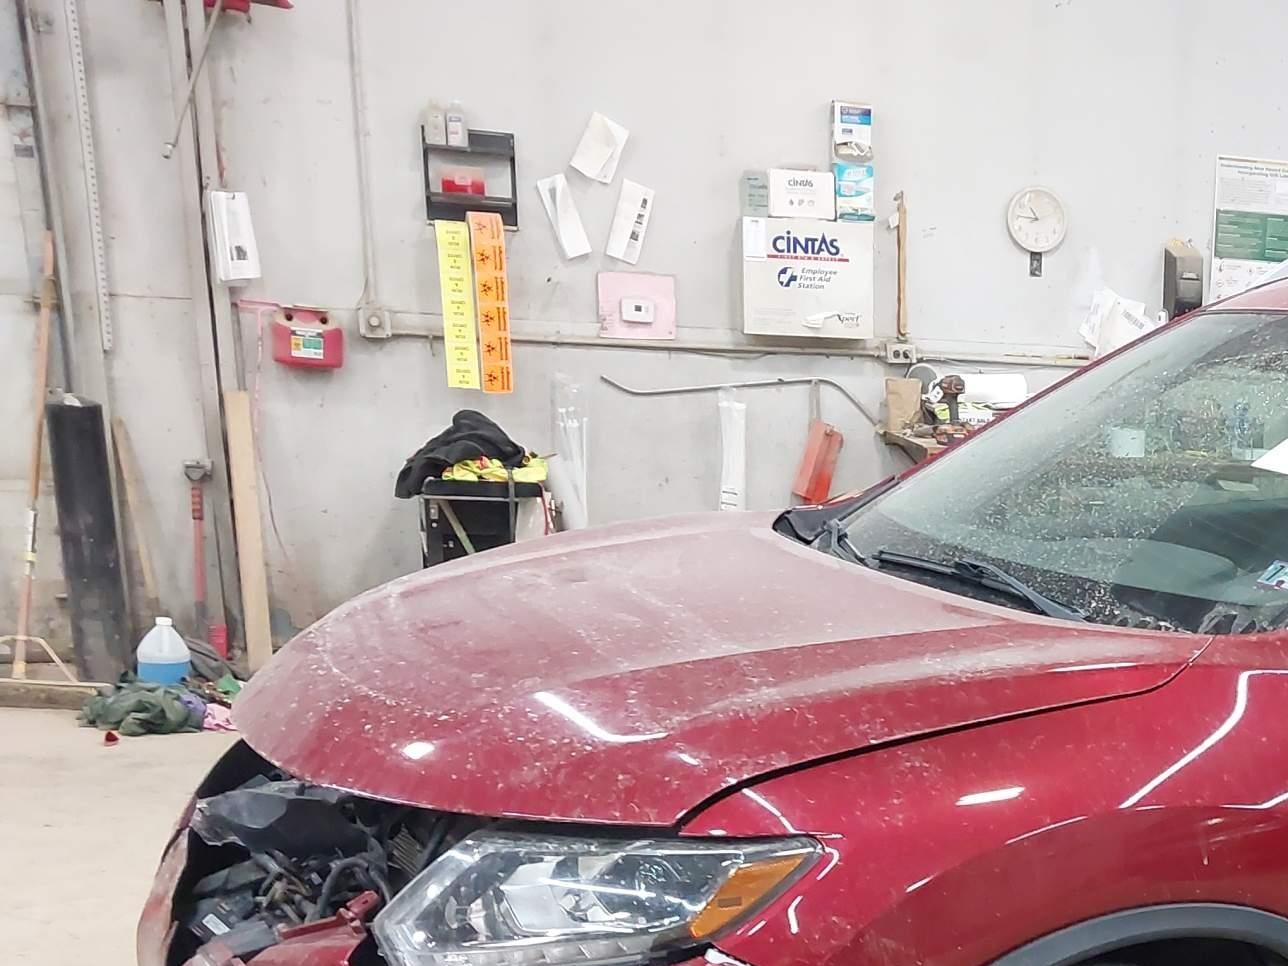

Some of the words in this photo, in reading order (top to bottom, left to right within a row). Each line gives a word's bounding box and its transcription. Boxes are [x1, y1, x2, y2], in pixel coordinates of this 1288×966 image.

[801, 267, 837, 277] Employee
[817, 275, 831, 283] Aid
[797, 282, 825, 290] Station
